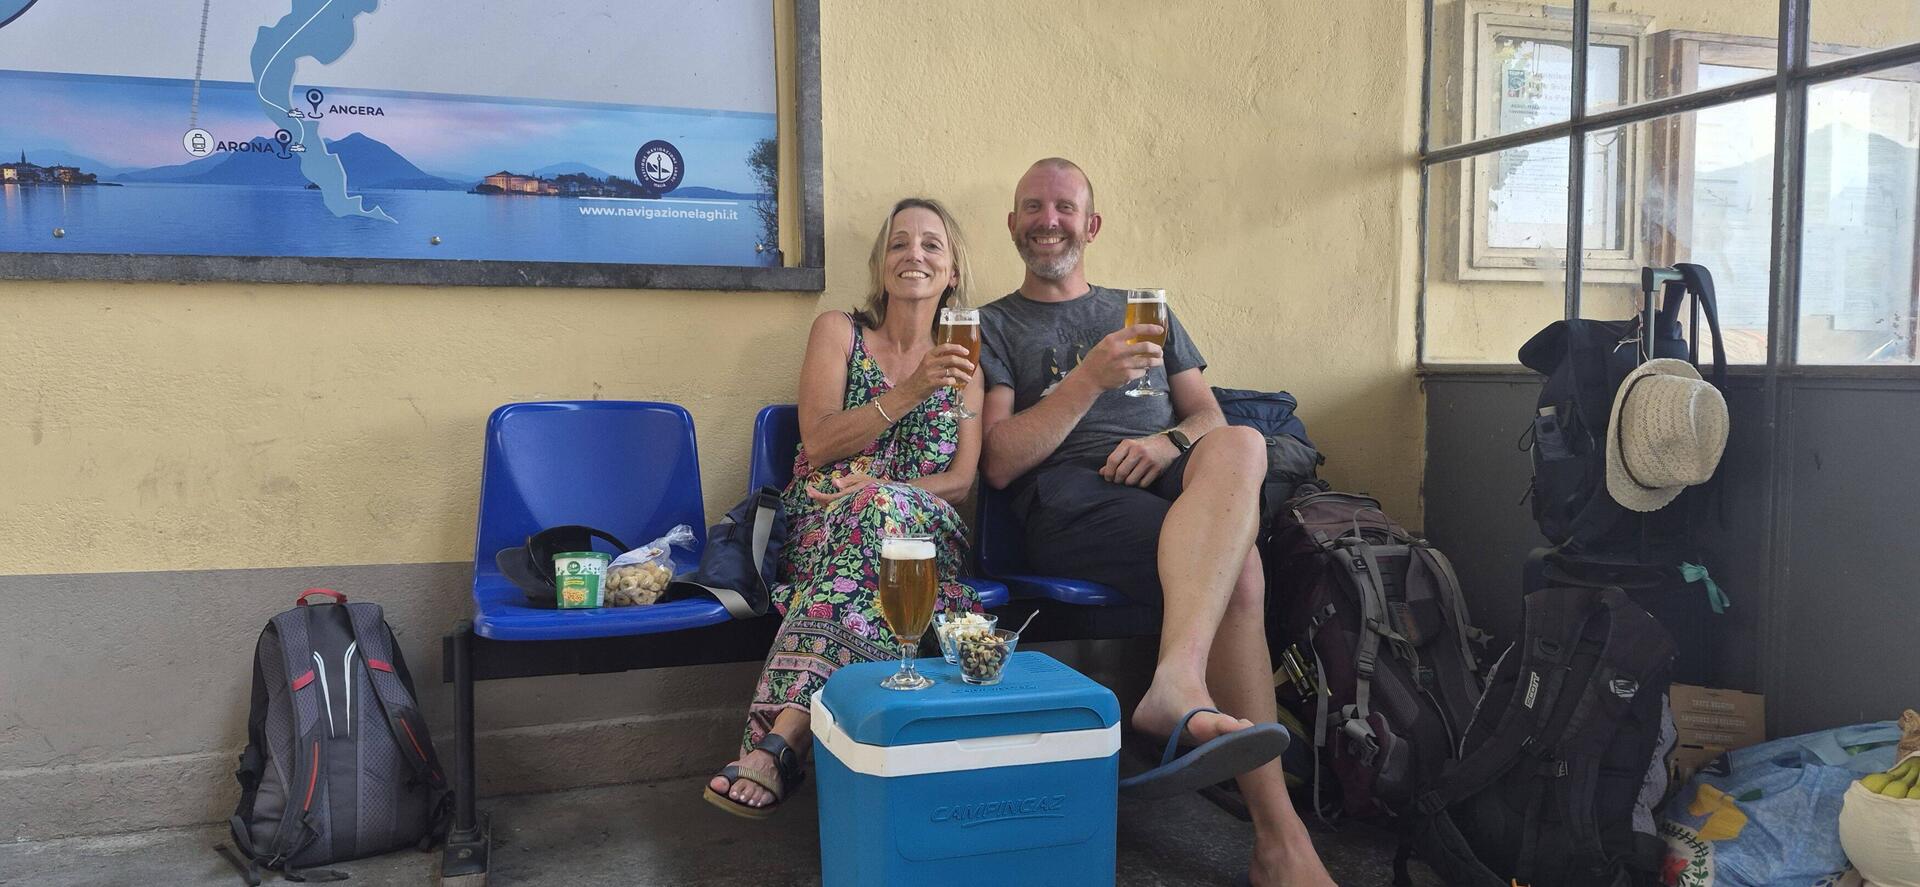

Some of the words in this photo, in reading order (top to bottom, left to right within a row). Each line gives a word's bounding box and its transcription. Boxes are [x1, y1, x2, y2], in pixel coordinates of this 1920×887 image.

[328, 104, 385, 117] ANGERA
[216, 140, 274, 154] ARONA
[646, 147, 677, 164] NAVIGAZIONE
[579, 205, 739, 221] www.navigazionelaghi.it
[1525, 672, 1540, 708] SCOTT
[930, 794, 1066, 822] CAMPINGAZ
